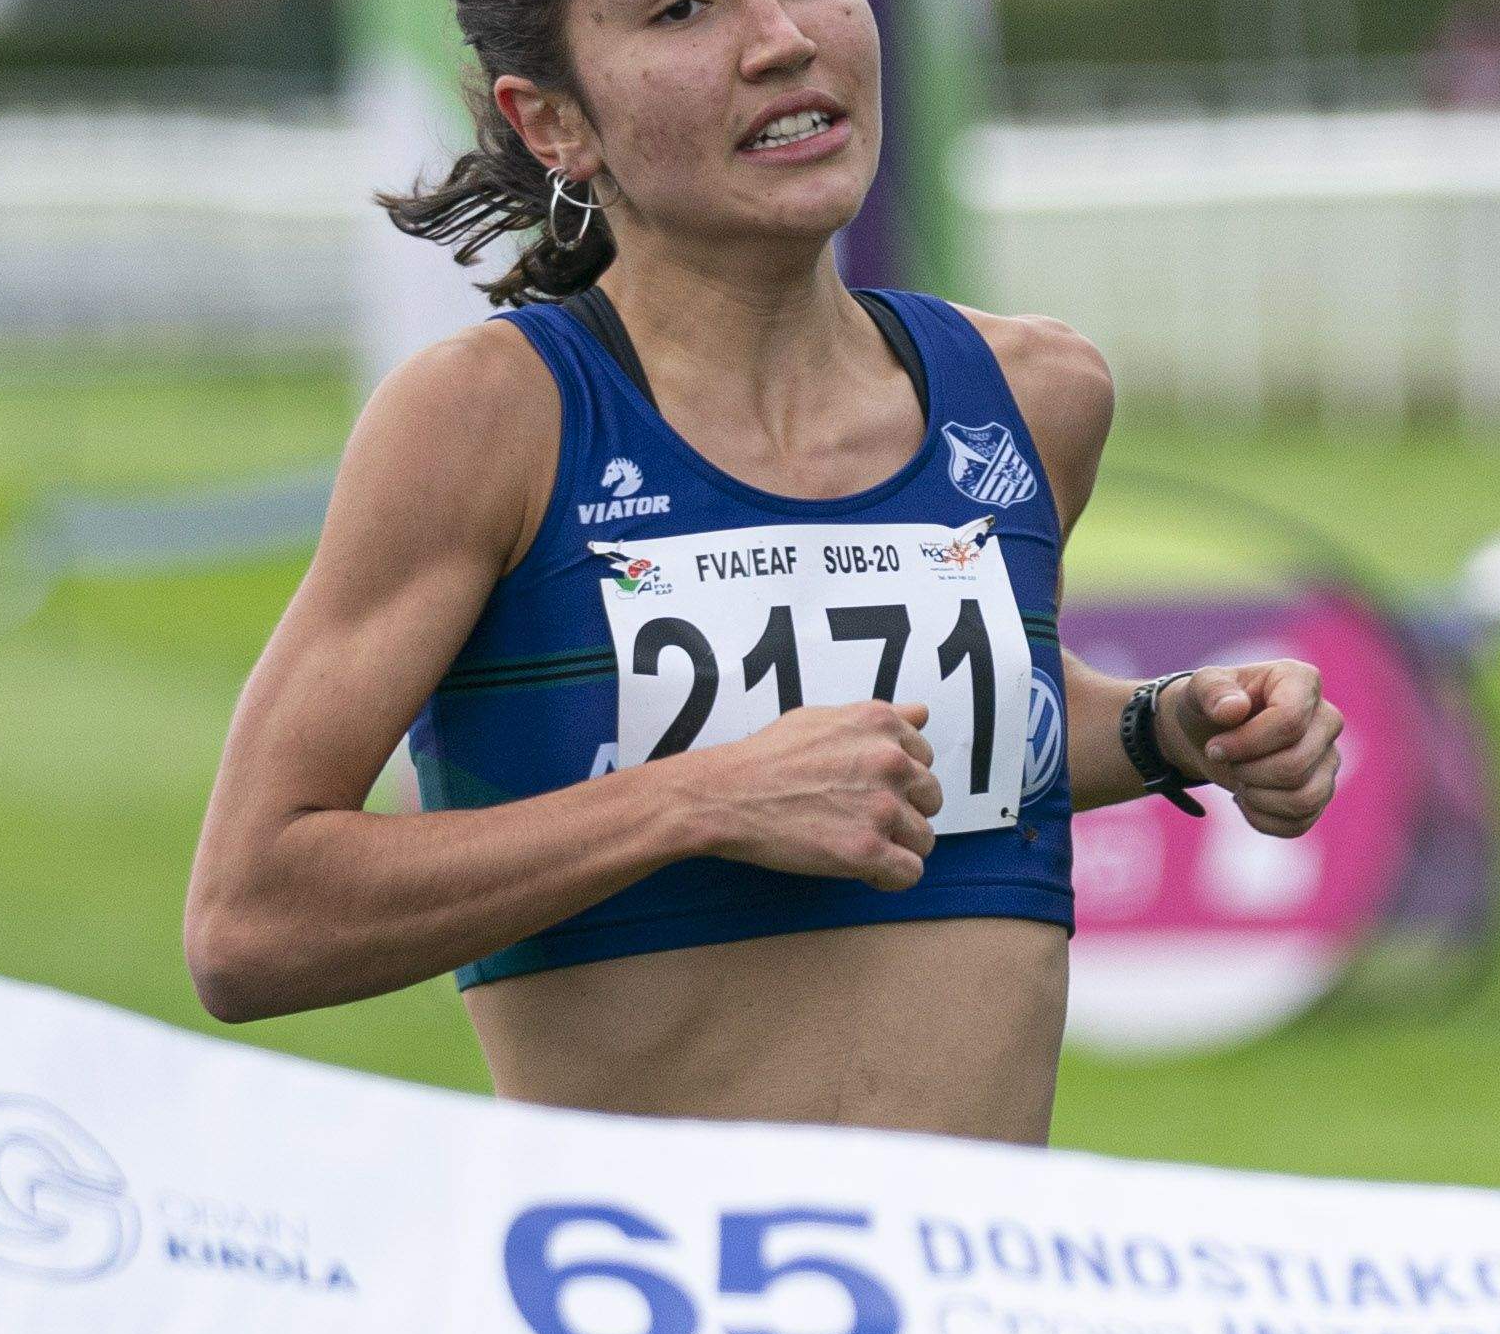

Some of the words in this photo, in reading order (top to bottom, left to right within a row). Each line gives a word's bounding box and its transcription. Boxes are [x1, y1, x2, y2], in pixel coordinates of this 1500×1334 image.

[577, 495, 670, 525] VIATOR
[695, 546, 798, 582] FVA/EAF
[823, 544, 900, 574] SUB-20
[632, 599, 996, 795] 2171
[163, 1231, 358, 1293] KIROLA
